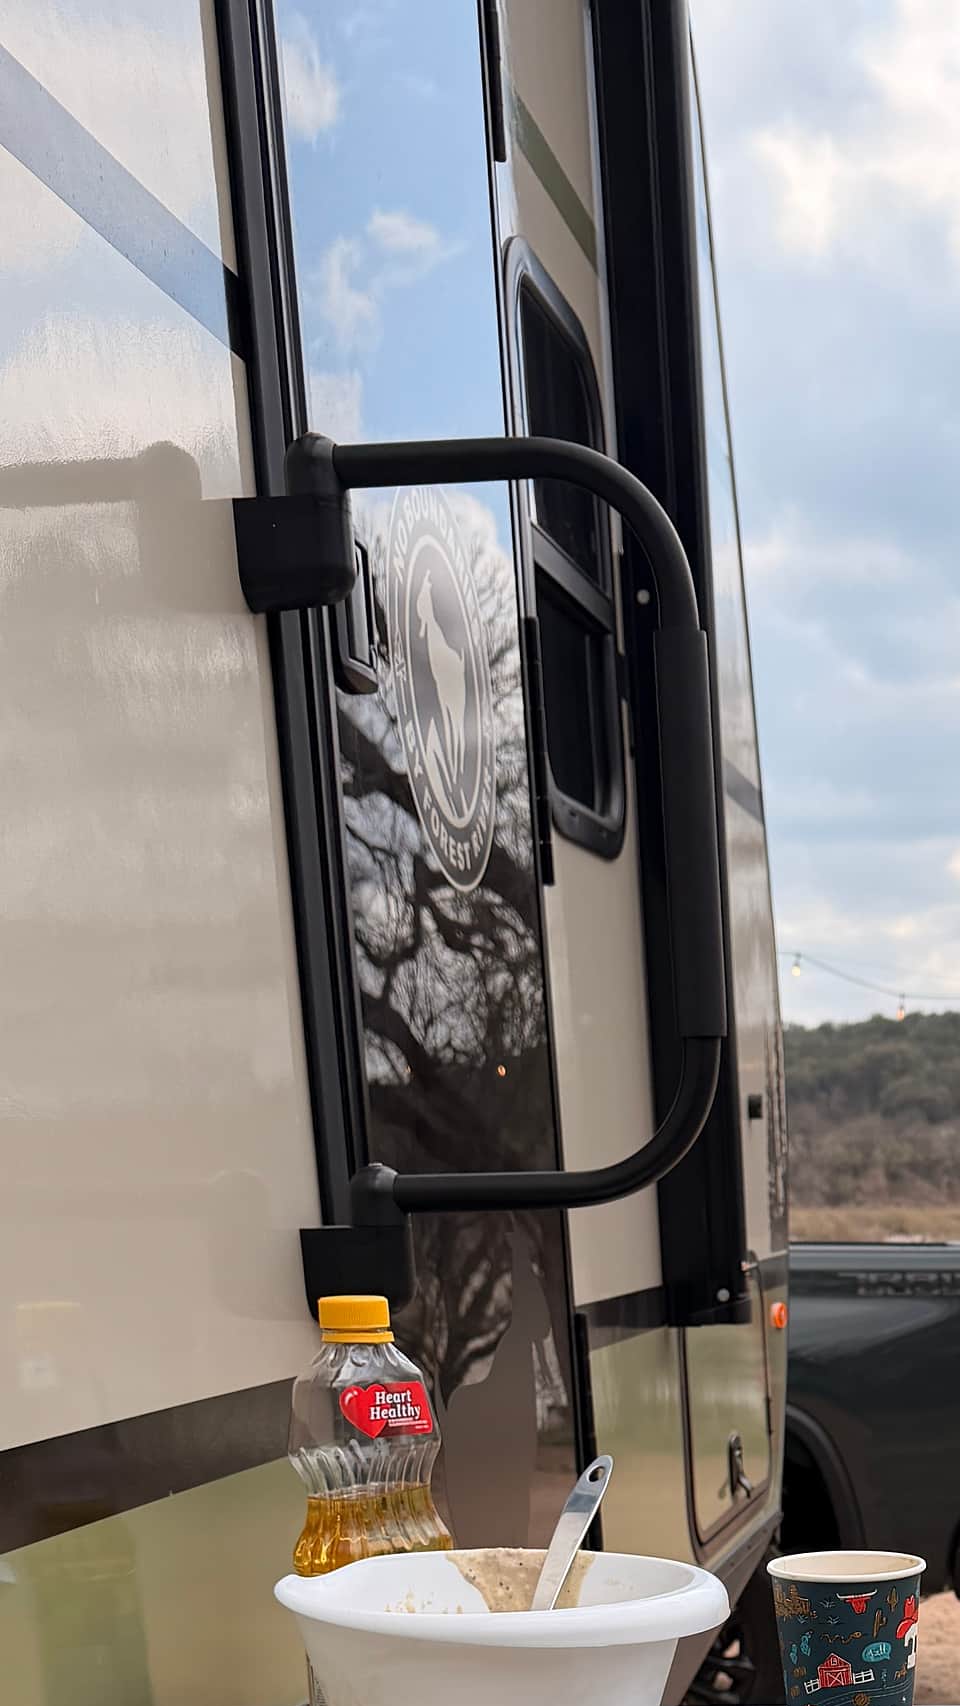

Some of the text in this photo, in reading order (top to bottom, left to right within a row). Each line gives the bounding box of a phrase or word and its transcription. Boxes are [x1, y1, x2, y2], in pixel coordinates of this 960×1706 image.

[405, 719, 423, 779] BY
[423, 785, 472, 872] FOREST
[375, 1389, 412, 1405] Heart
[369, 1403, 421, 1420] Healthy
